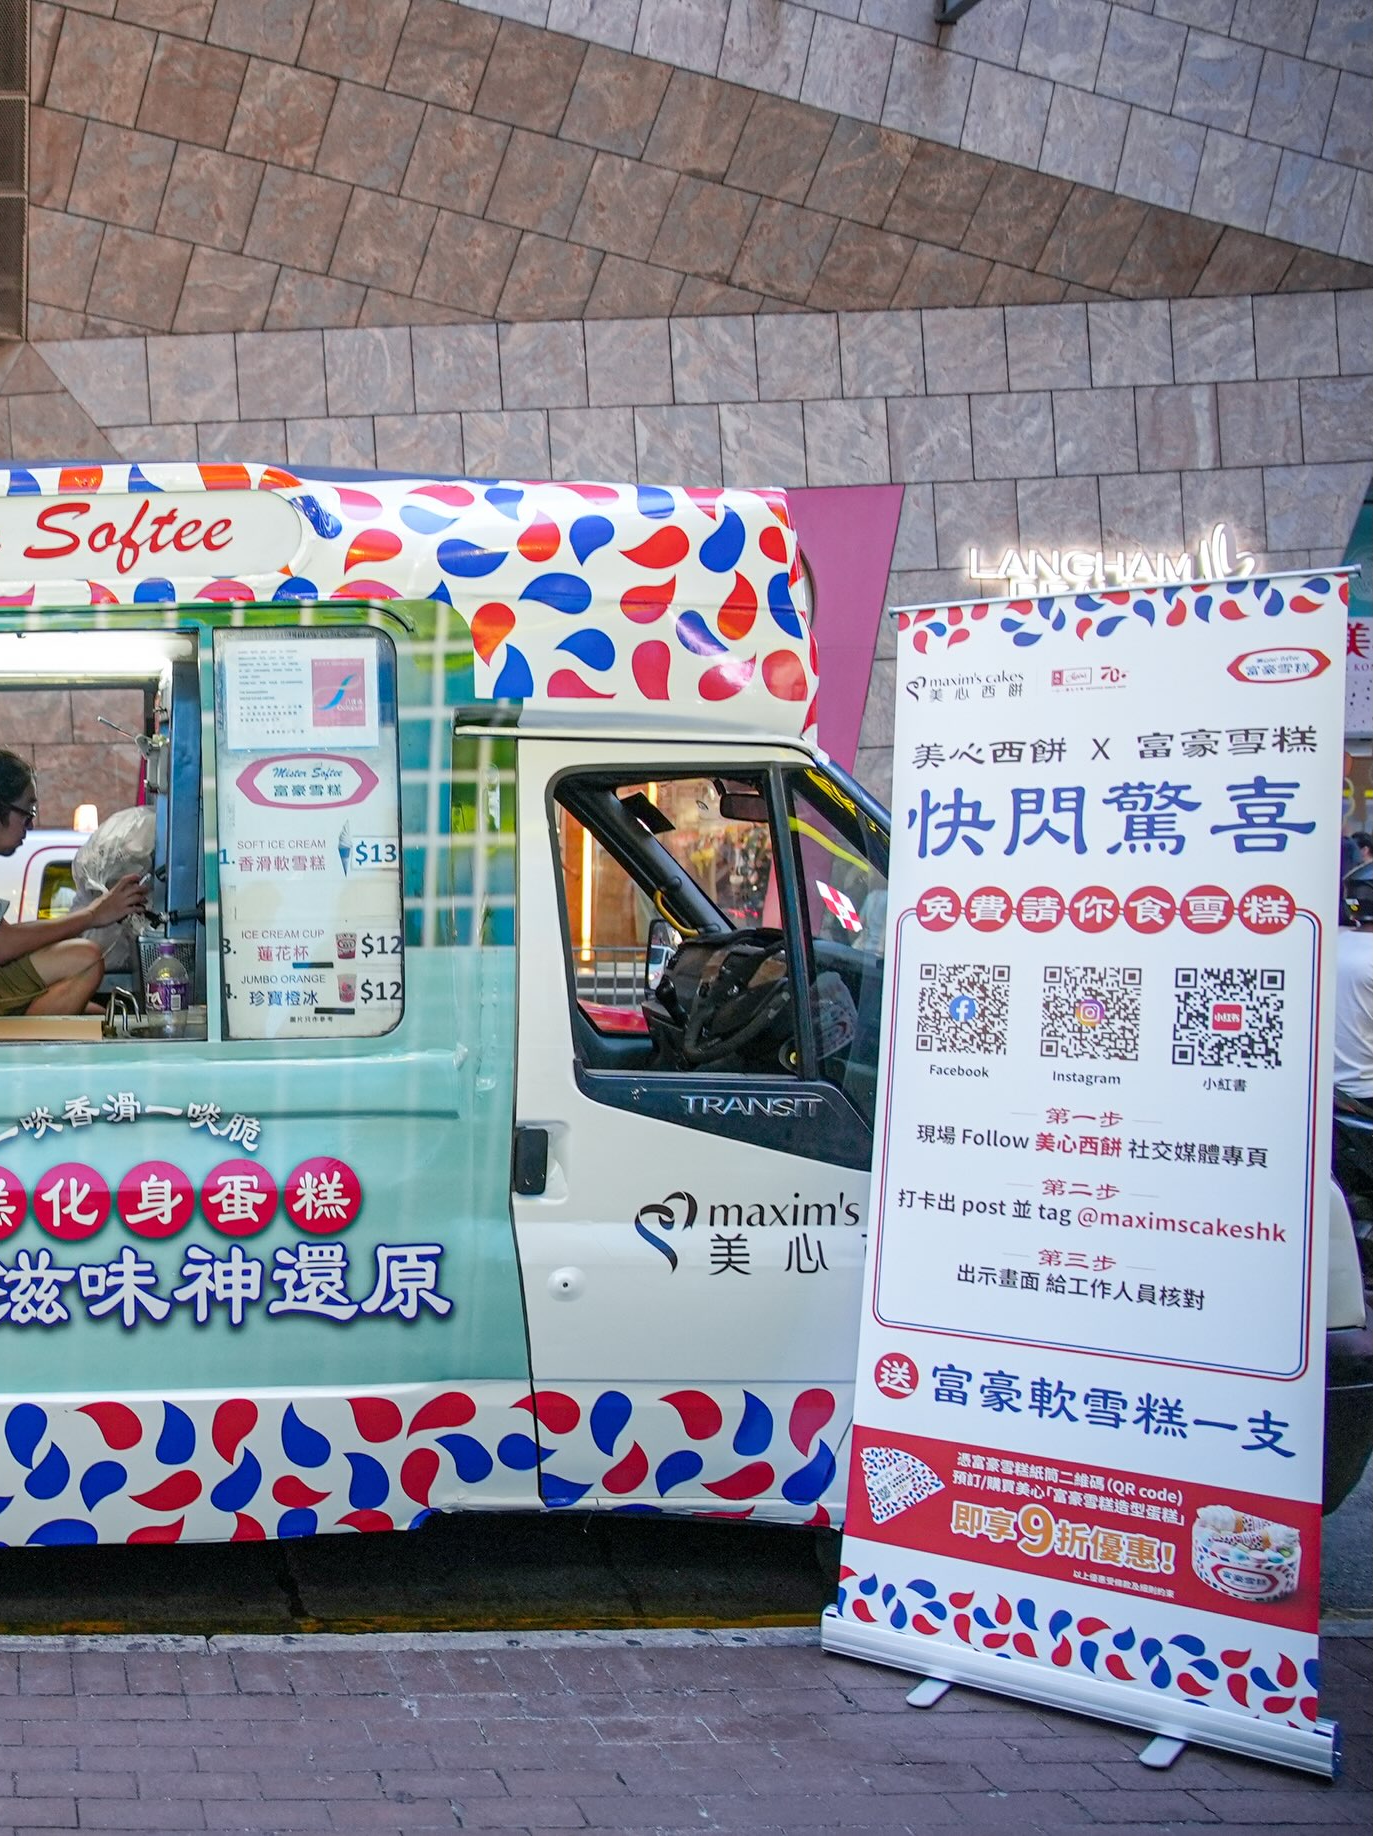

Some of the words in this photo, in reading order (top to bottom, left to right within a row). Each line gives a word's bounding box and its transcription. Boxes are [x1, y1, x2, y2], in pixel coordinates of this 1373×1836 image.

[23, 500, 233, 574] Softee
[970, 548, 1192, 583] LANGHAM
[930, 673, 981, 687] maxim's
[986, 670, 1023, 684] cakes
[930, 683, 1023, 702] 美心西餅
[912, 736, 1067, 769] 美心西餅
[1092, 737, 1111, 760] X
[1136, 726, 1318, 760] 富豪雪糕
[272, 767, 306, 777] Mister
[311, 767, 343, 780] Softee
[274, 784, 342, 796] 富豪雪糕
[907, 775, 1317, 859] 快閃驚喜
[237, 840, 264, 849] SOFT
[268, 840, 285, 848] ICE
[288, 840, 326, 848] CREAM
[239, 856, 326, 872] 香滑軟雪糕
[355, 841, 396, 865] $13
[921, 894, 1289, 926] 免費請你食雪糕
[242, 931, 259, 939] ICE
[261, 930, 300, 939] CREAM
[303, 930, 325, 938] CUP
[257, 945, 309, 962] 蓮花杯
[361, 933, 402, 957] $12
[241, 975, 278, 984] JUMBO
[281, 975, 326, 984] ORANGE
[249, 990, 319, 1007] 珍寶橙冰
[360, 979, 402, 1004] $12
[929, 1064, 989, 1078] Facebook
[1052, 1071, 1121, 1086] Instagram
[1202, 1077, 1246, 1092] 小紅書
[680, 1095, 823, 1117] TRANSIT
[1045, 1107, 1124, 1129] 第一步
[917, 1124, 955, 1146] 現場
[962, 1128, 1030, 1150] Follow
[1034, 1133, 1123, 1157] 美心西餅
[1128, 1138, 1268, 1168] 社交媒體專頁
[1041, 1178, 1121, 1200] 第二步
[709, 1191, 860, 1226] maxim's
[898, 1189, 955, 1212] 打卡出
[962, 1197, 1007, 1220] post
[1012, 1199, 1031, 1219] 並
[1038, 1204, 1071, 1228] tag
[1077, 1207, 1286, 1242] @maximscakeshk
[709, 1232, 867, 1276] 美心
[1037, 1249, 1117, 1272] 第三步
[957, 1264, 1040, 1292] 出示畫面
[1045, 1274, 1205, 1311] 給工作人員核對
[879, 1360, 915, 1394] 送
[931, 1363, 1297, 1458] 富豪軟雪糕一支
[1107, 1477, 1136, 1497] (QR
[1139, 1483, 1183, 1506] code)
